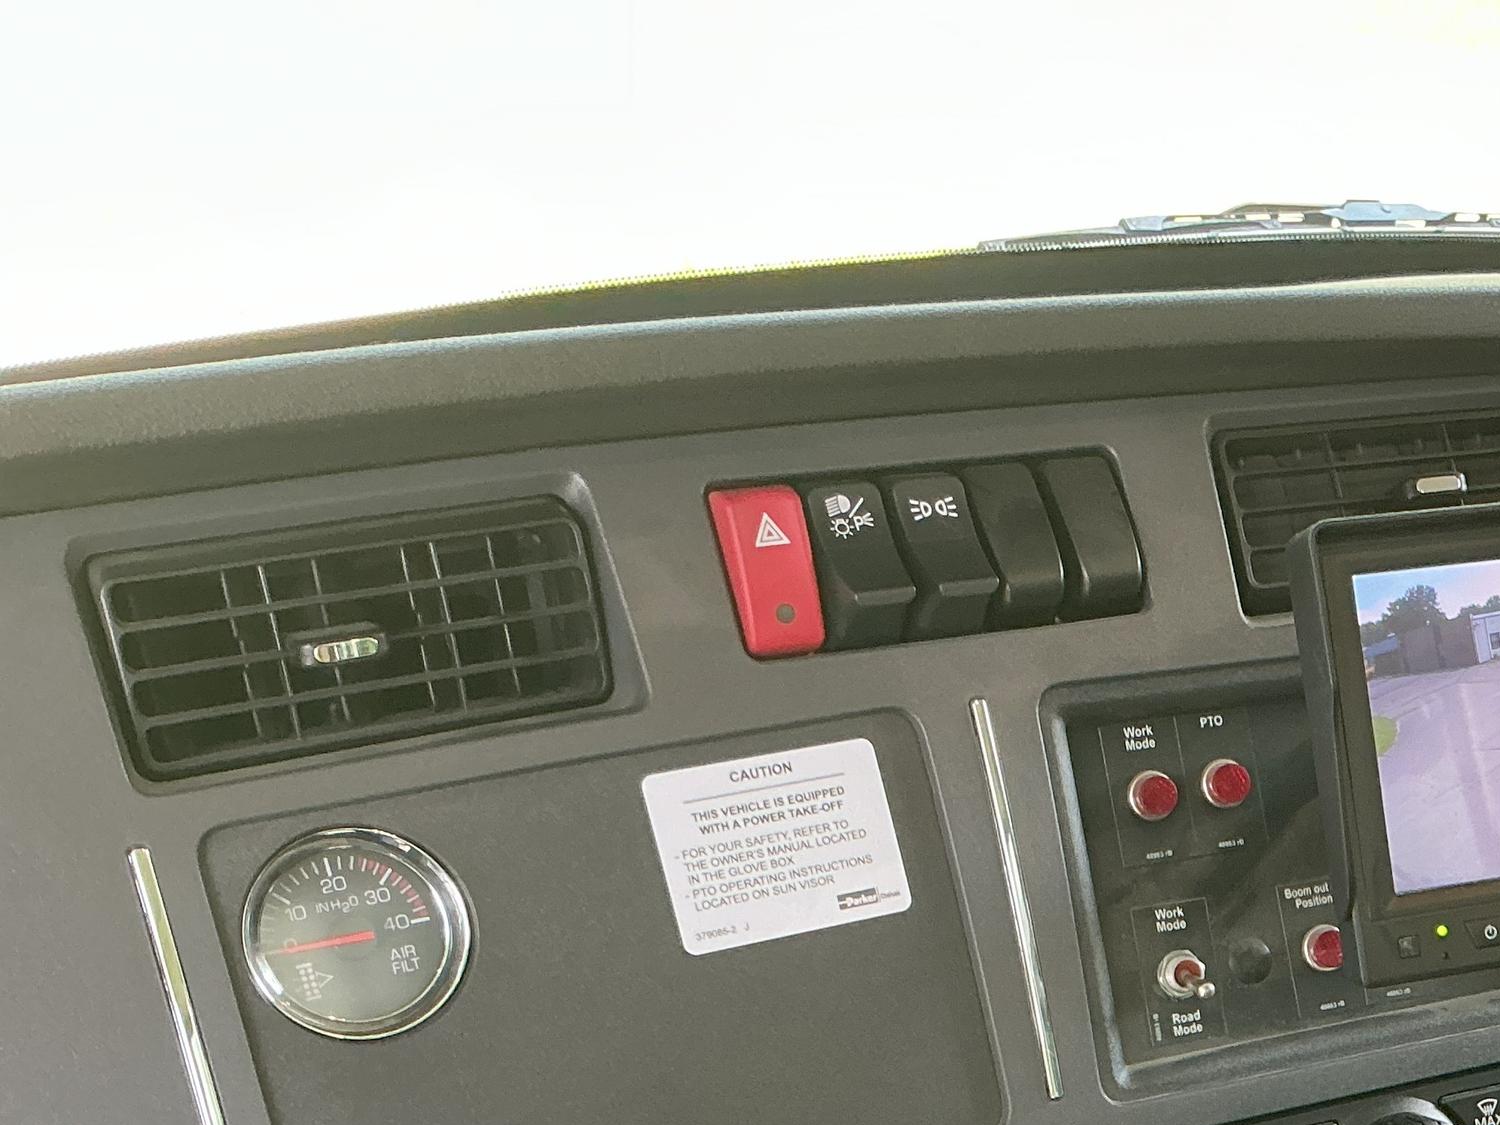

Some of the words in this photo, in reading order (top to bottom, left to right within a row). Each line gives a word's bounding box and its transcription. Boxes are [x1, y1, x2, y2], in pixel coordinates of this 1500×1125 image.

[1200, 715, 1223, 728] PTO
[1123, 725, 1153, 739] Work
[1125, 738, 1156, 752] Mode
[729, 761, 793, 783] CAUTION
[691, 810, 718, 823] THIS
[721, 800, 771, 818] VEHICLE
[773, 797, 784, 808] IS
[788, 785, 845, 807] EQUIPPED
[700, 821, 730, 835] WITH
[732, 818, 741, 829] A
[743, 810, 786, 827] POWER
[788, 800, 844, 819] TAKE-OFF
[682, 846, 707, 861] FOR
[709, 839, 743, 855] YOUR
[794, 823, 831, 838] REFER
[832, 819, 849, 830] TO
[684, 860, 709, 872] THE
[710, 848, 765, 868] OWNER'S
[767, 840, 815, 859] MANUAL
[815, 828, 867, 847] LOCATED
[688, 874, 699, 885] IN
[700, 869, 726, 883] THE
[729, 860, 768, 876] GLOVE
[771, 855, 795, 869] BOX
[692, 885, 717, 900] PTO
[720, 871, 786, 895] OPERATING
[788, 854, 873, 881] INSTRUCTIONS
[320, 876, 347, 894] 20
[694, 893, 750, 912] LOCATED
[752, 889, 769, 901] ON
[772, 883, 797, 897] SUN
[799, 874, 835, 891] VISOR
[1284, 885, 1312, 900] Boom
[1314, 882, 1330, 895] out
[364, 887, 391, 905] 30
[1295, 894, 1333, 909] Position
[285, 905, 307, 922] 10
[384, 914, 410, 931] 40
[1154, 906, 1184, 921] Work
[1156, 919, 1187, 933] Mode
[390, 944, 416, 960] AIR
[392, 957, 420, 975] FILT
[1172, 1009, 1201, 1024] Road
[1173, 1022, 1203, 1037] Mode
